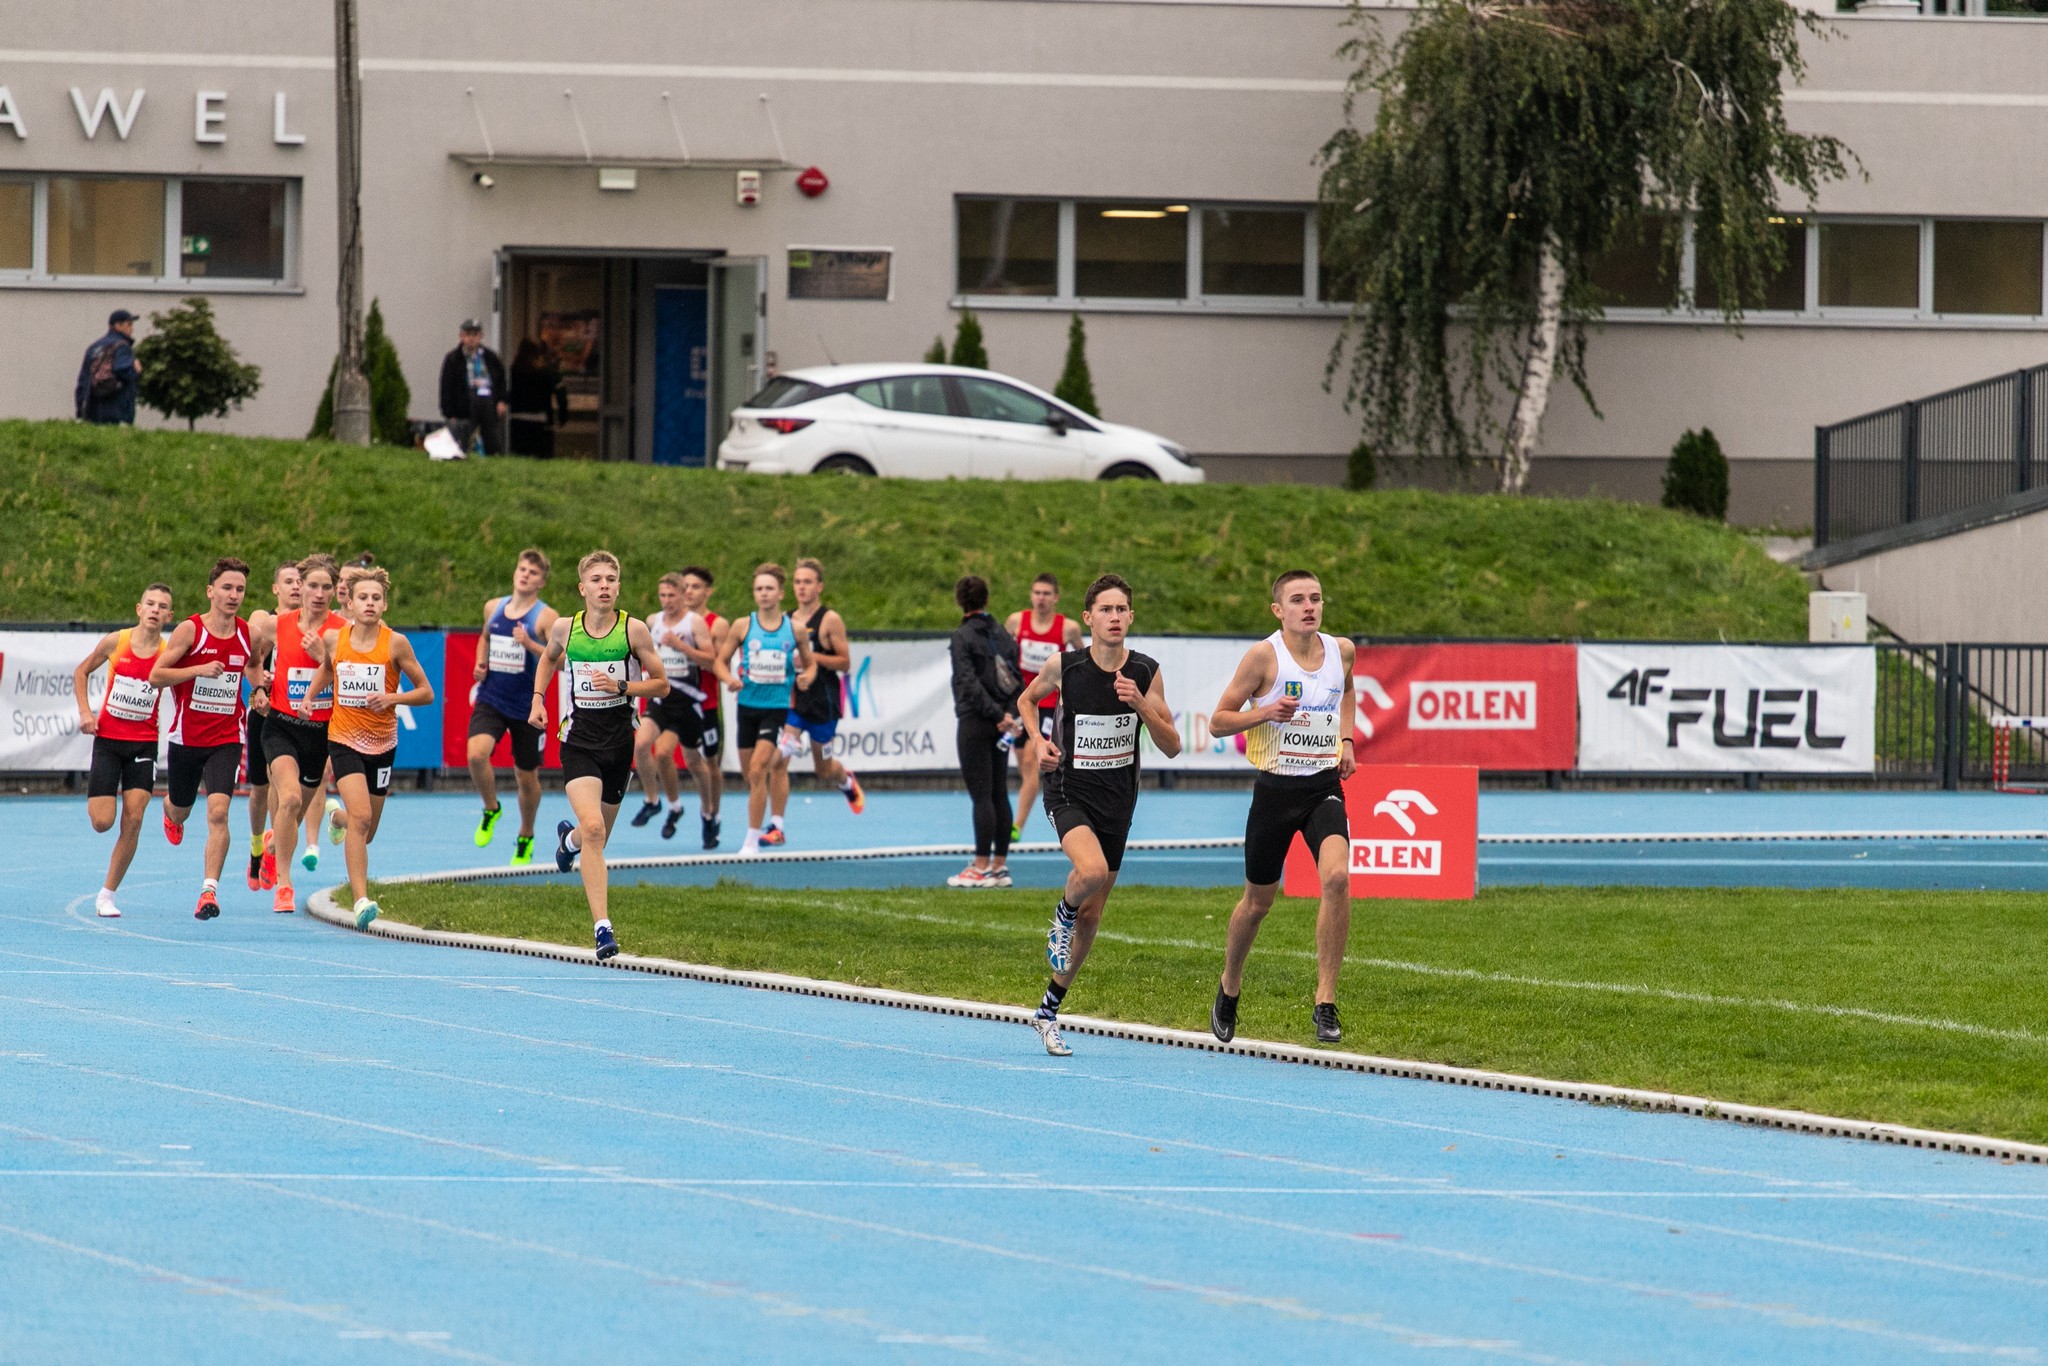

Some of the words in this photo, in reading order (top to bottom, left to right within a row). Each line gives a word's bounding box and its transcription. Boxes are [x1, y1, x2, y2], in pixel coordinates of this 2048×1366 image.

[367, 667, 379, 676] 17
[608, 664, 616, 674] 6
[225, 673, 238, 684] 30
[141, 684, 154, 695] 26
[342, 681, 379, 692] SAMUL
[1608, 668, 1670, 706] 4F
[112, 691, 155, 709] WINIARSKI
[608, 698, 622, 706] 2022
[1416, 691, 1527, 720] ORLEN
[110, 709, 133, 719] KRAKÓW
[194, 704, 220, 712] KRAKÓW
[12, 708, 75, 741] Sportu
[277, 713, 301, 725] NIKE
[302, 720, 324, 728] PRO
[1115, 715, 1130, 728] 33
[1326, 713, 1333, 727] 9
[1666, 688, 1846, 749] FUEL
[832, 730, 935, 757] OPOLSKA
[1077, 734, 1134, 750] ZAKRZEWSKI
[1283, 732, 1336, 748] KOWALSKI
[1081, 760, 1113, 768] KRAKÓW
[1115, 758, 1129, 766] 2022
[1285, 757, 1317, 766] KRAKÓW
[381, 770, 389, 785] 7
[1352, 846, 1432, 869] RLEN
